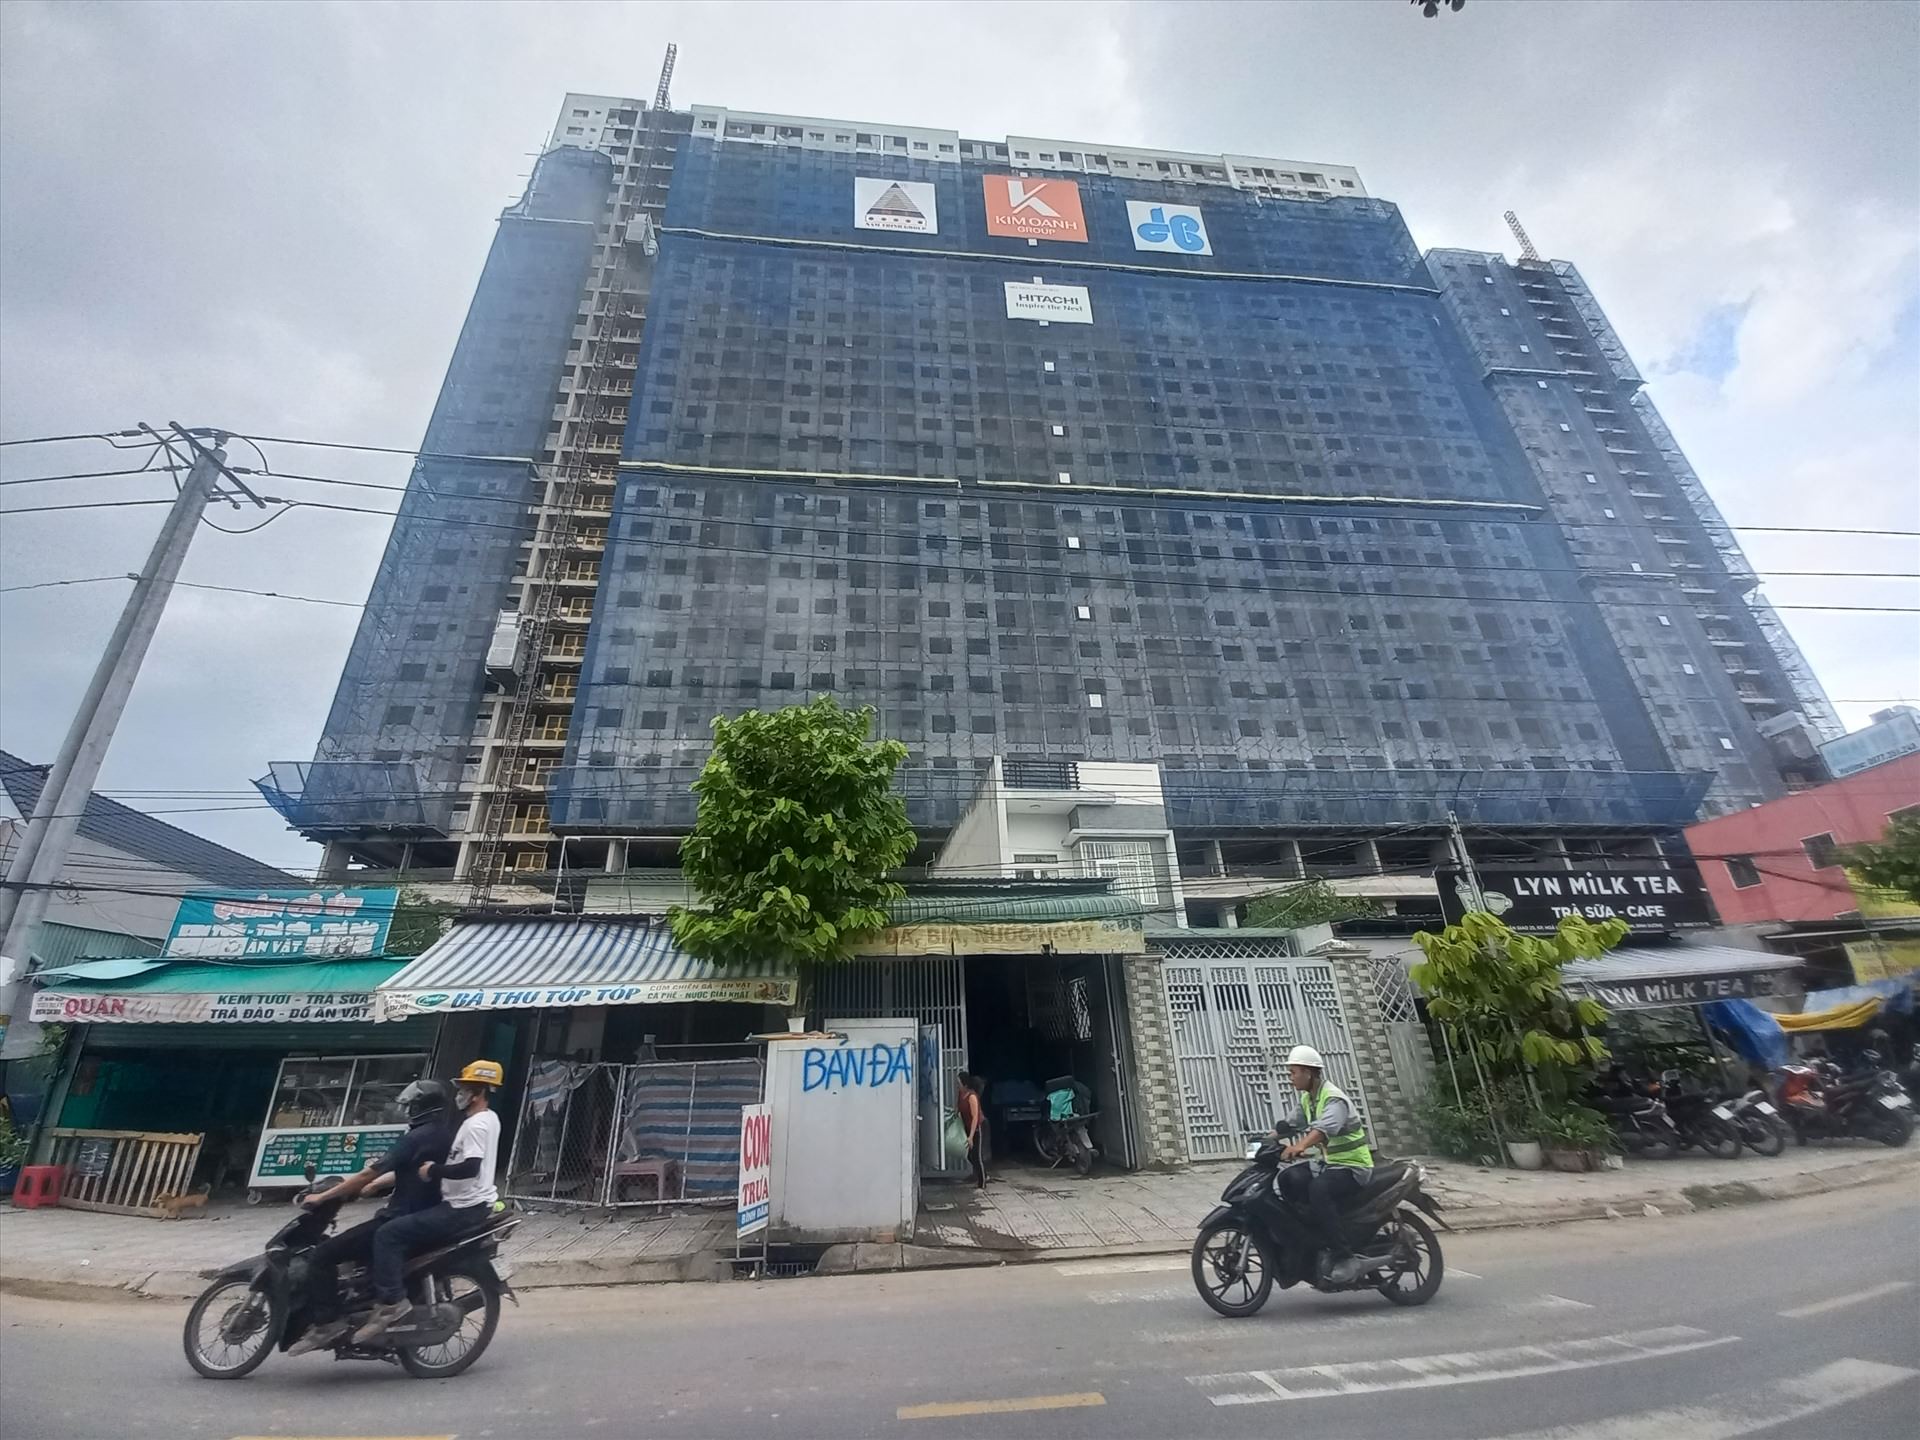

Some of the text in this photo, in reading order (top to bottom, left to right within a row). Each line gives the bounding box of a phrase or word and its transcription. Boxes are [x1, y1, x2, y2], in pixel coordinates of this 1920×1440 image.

[995, 215, 1078, 230] KIM OANH
[1017, 226, 1056, 235] GROUP
[1018, 294, 1079, 305] HITACHI
[1513, 876, 1562, 896] LYN
[1632, 876, 1684, 894] TEA
[1551, 903, 1583, 919] TRÀ
[1627, 904, 1666, 917] CAFE
[217, 994, 252, 1005] KEM
[450, 988, 485, 1008] BÀ
[490, 990, 541, 1005] THU
[545, 986, 592, 1003] TÓP
[596, 984, 642, 1001] TÓP
[1599, 986, 1640, 1004] LYN
[1703, 979, 1745, 996] TEA
[64, 995, 128, 1017] QUÁN
[803, 1040, 866, 1092] BÁN
